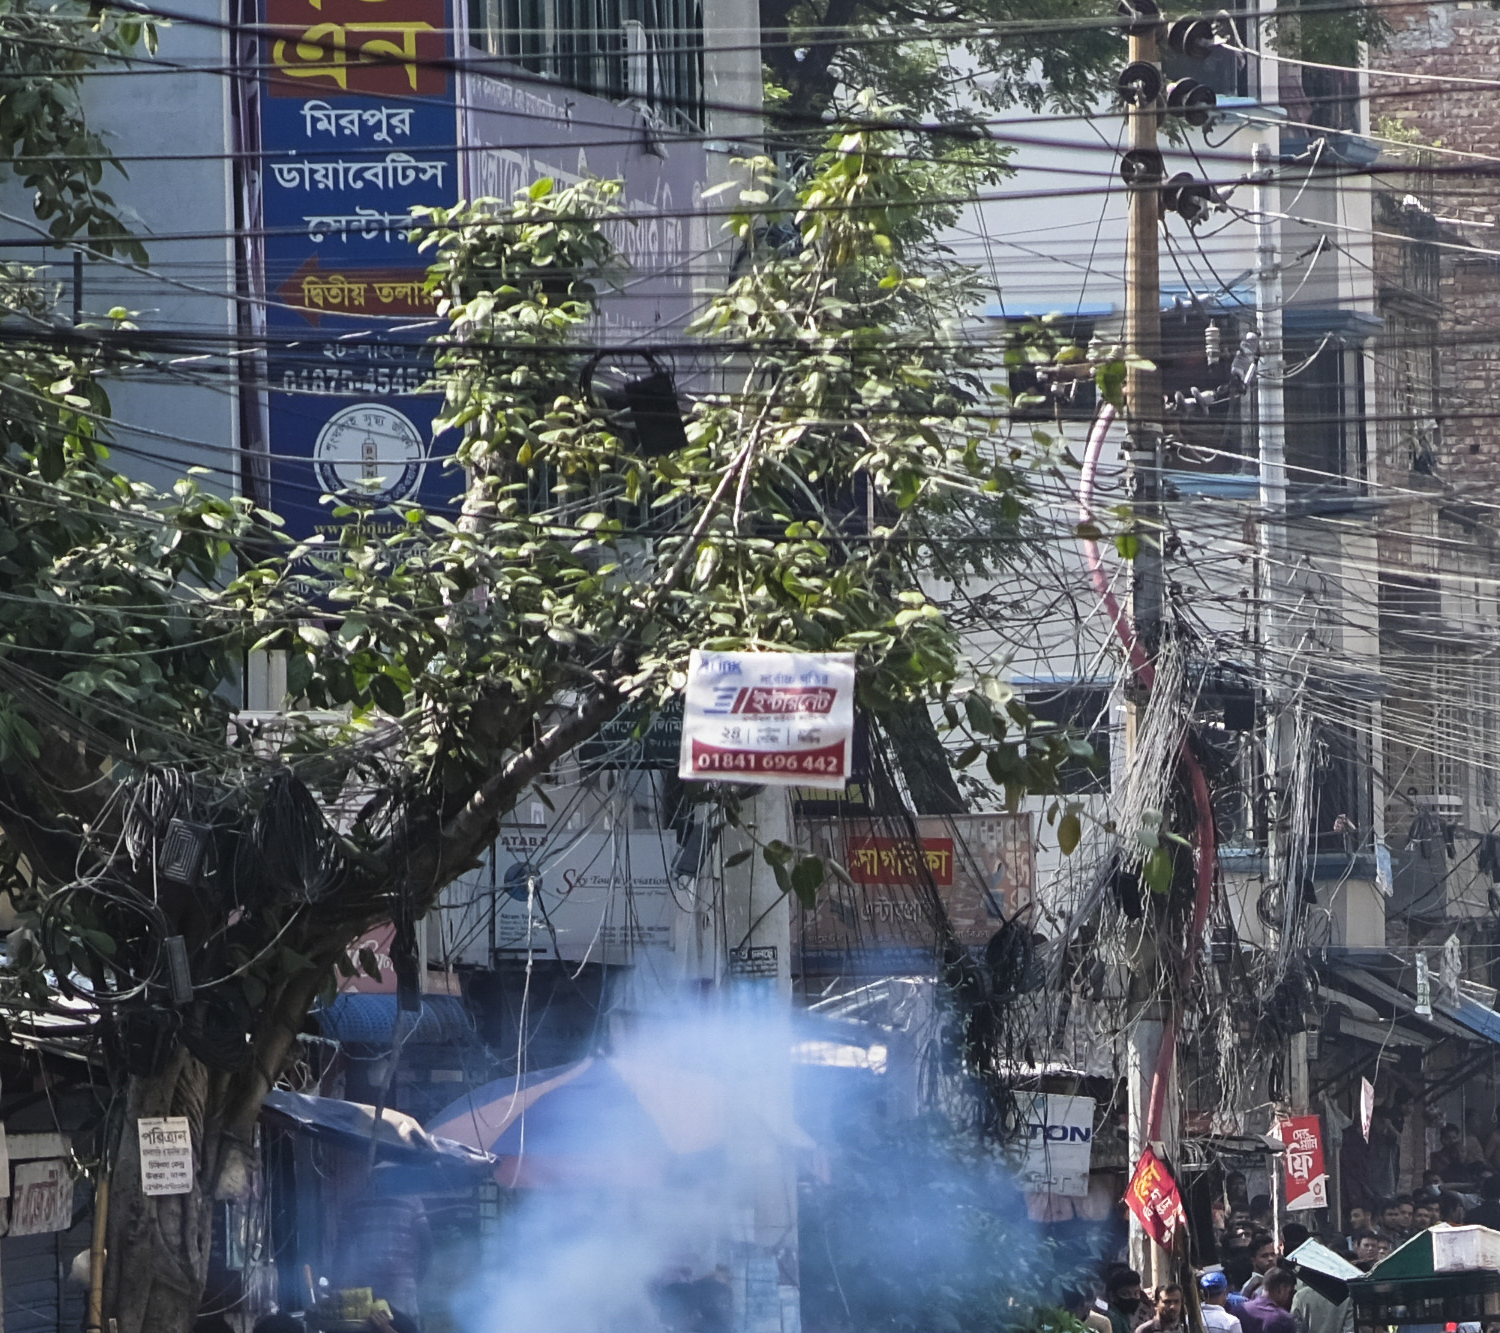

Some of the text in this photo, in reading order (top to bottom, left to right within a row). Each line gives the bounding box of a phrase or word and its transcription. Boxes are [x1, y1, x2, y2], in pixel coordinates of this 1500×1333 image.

[300, 100, 414, 144] মিরপুর
[270, 152, 448, 191] ডায়াবেটিস
[302, 205, 414, 243] সেন্টার
[302, 274, 367, 307] দ্বিতীয়
[752, 690, 831, 713] ইন্টারনেট
[699, 753, 838, 772] 01841 696 442
[1286, 1142, 1314, 1179] ফ্রি
